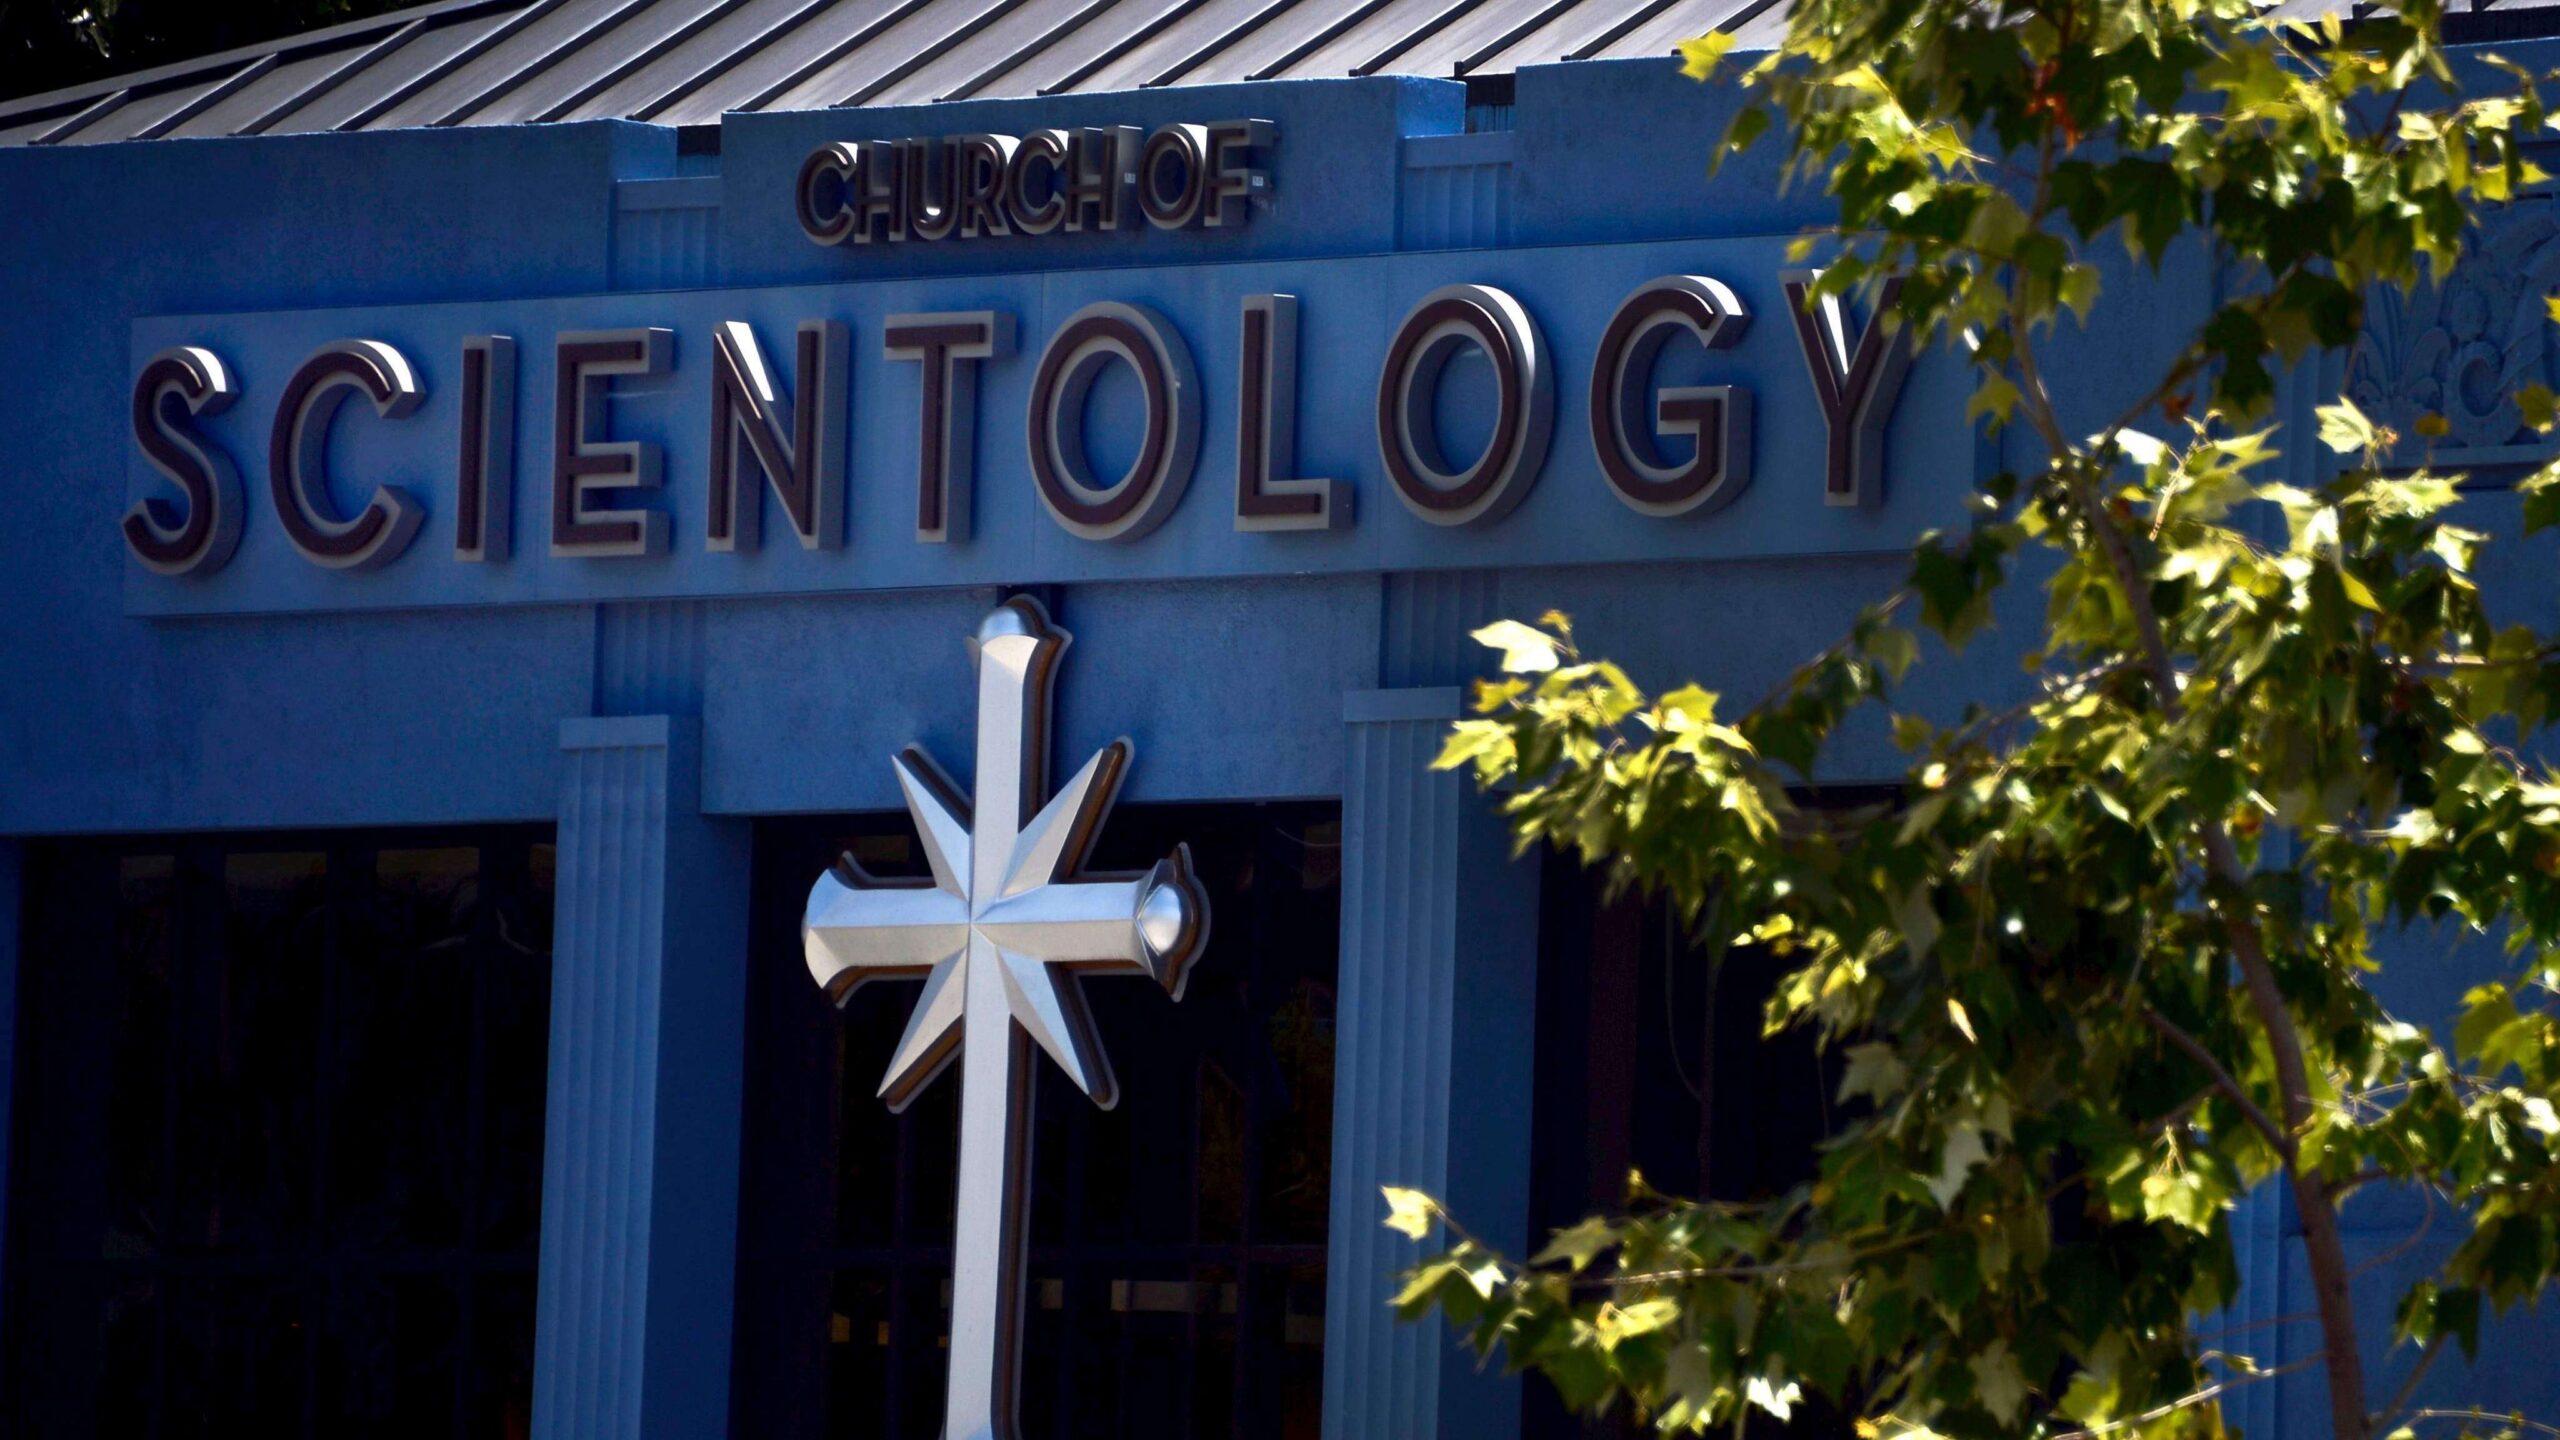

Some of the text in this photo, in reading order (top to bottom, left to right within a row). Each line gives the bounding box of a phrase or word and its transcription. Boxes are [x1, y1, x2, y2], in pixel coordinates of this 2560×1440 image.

[796, 119, 1273, 246] CHURCH OF
[123, 268, 1912, 578] SCIENTOLOGY
